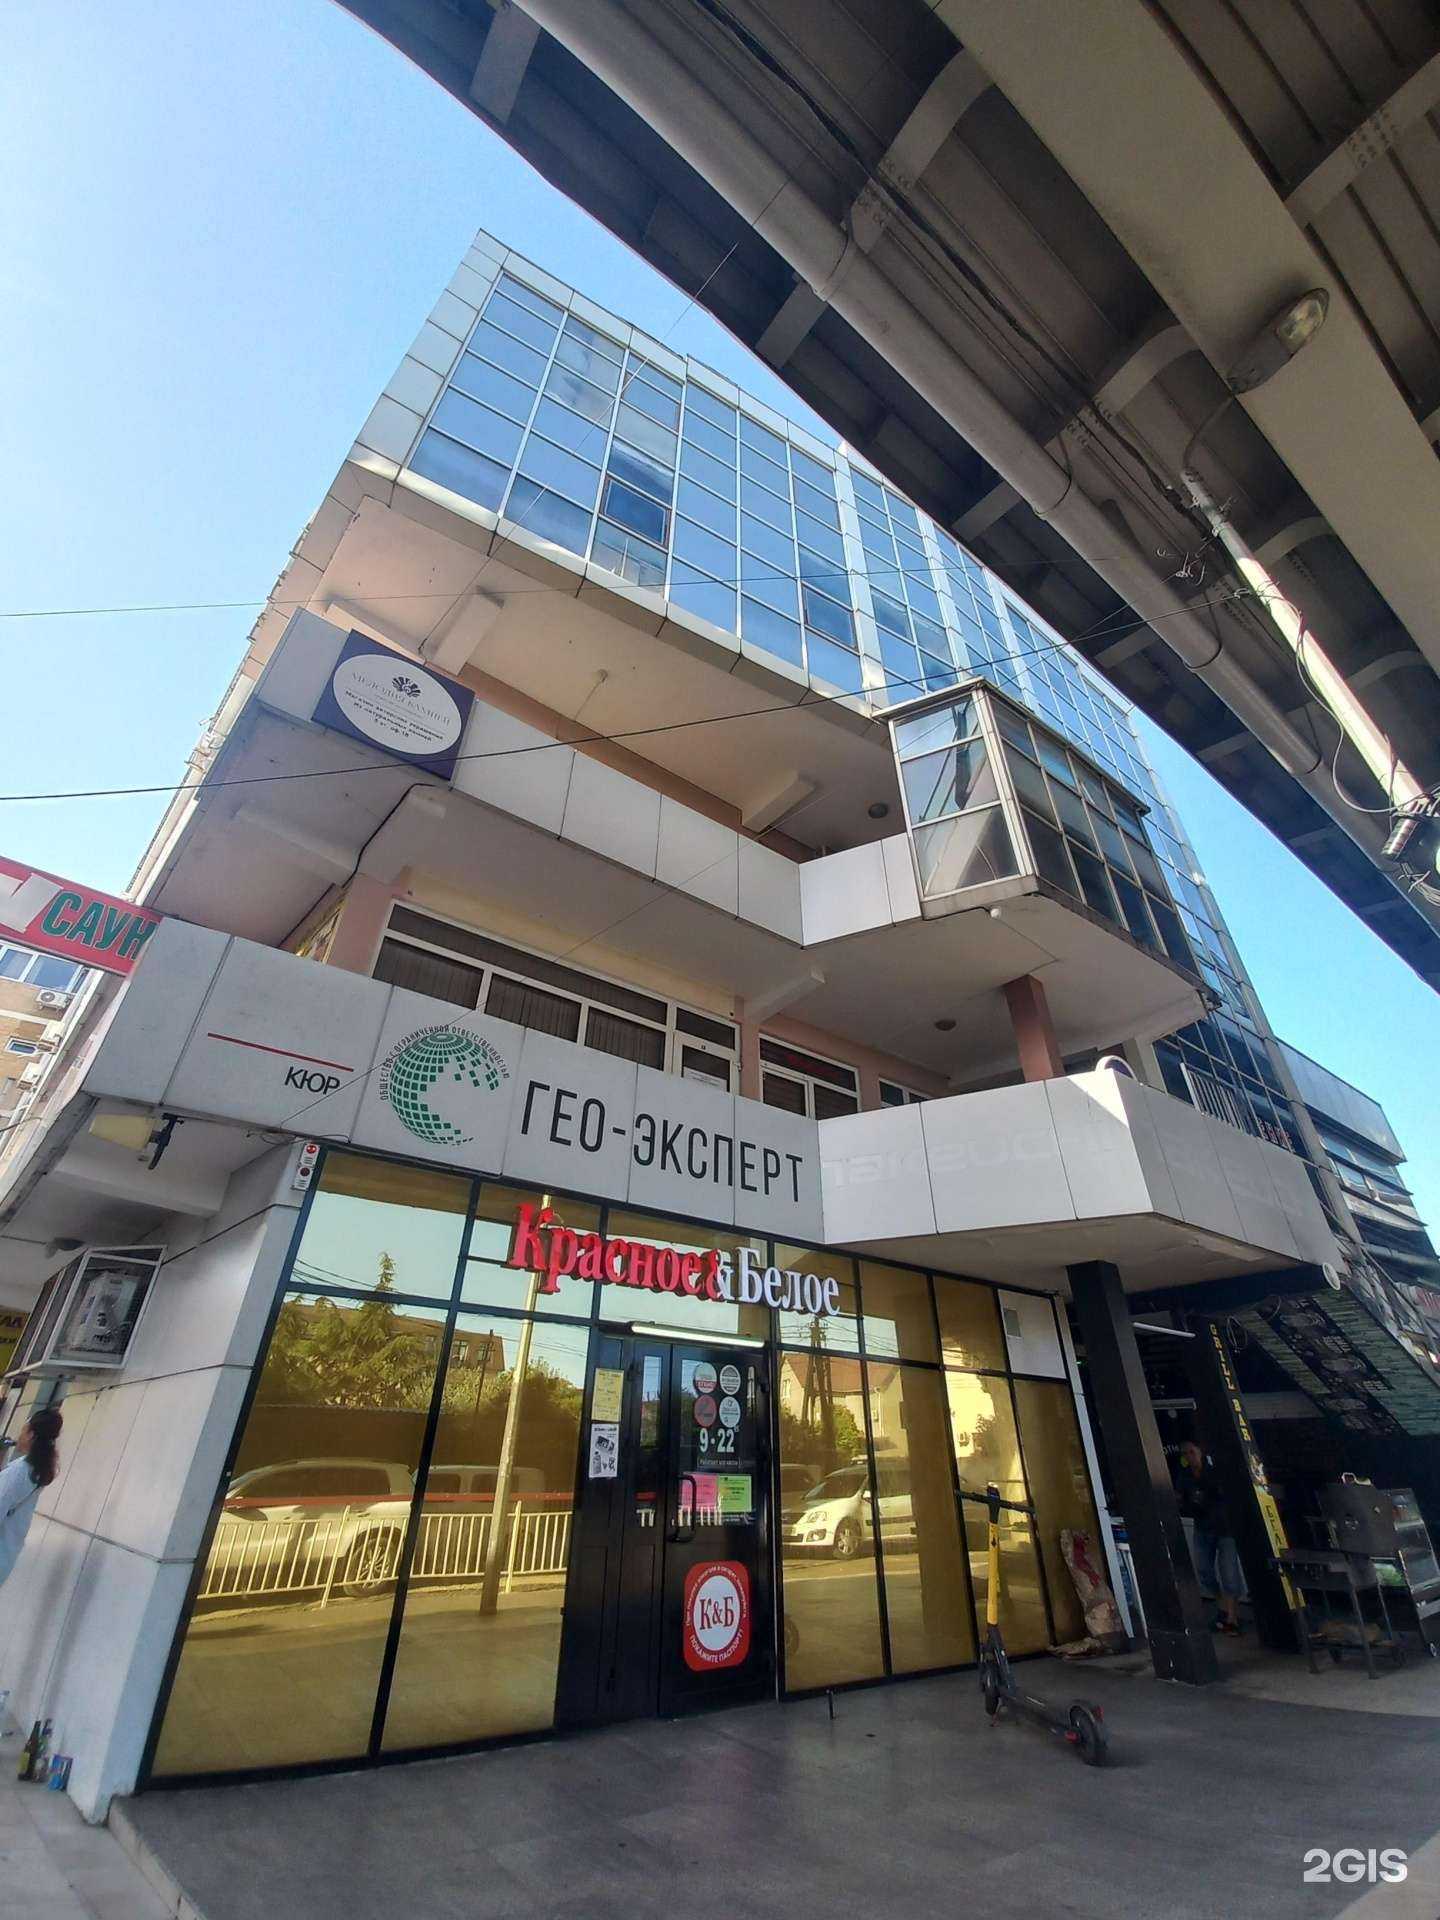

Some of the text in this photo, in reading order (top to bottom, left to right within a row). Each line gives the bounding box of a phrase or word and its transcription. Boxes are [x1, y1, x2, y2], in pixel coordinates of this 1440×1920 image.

[284, 1065, 341, 1097] КЮР
[521, 1079, 803, 1203] ГЕО-ЭКСПЕРТ
[508, 1203, 704, 1297] Красное
[736, 1246, 841, 1317] Белое
[1210, 1324, 1251, 1441] GRILL BAR
